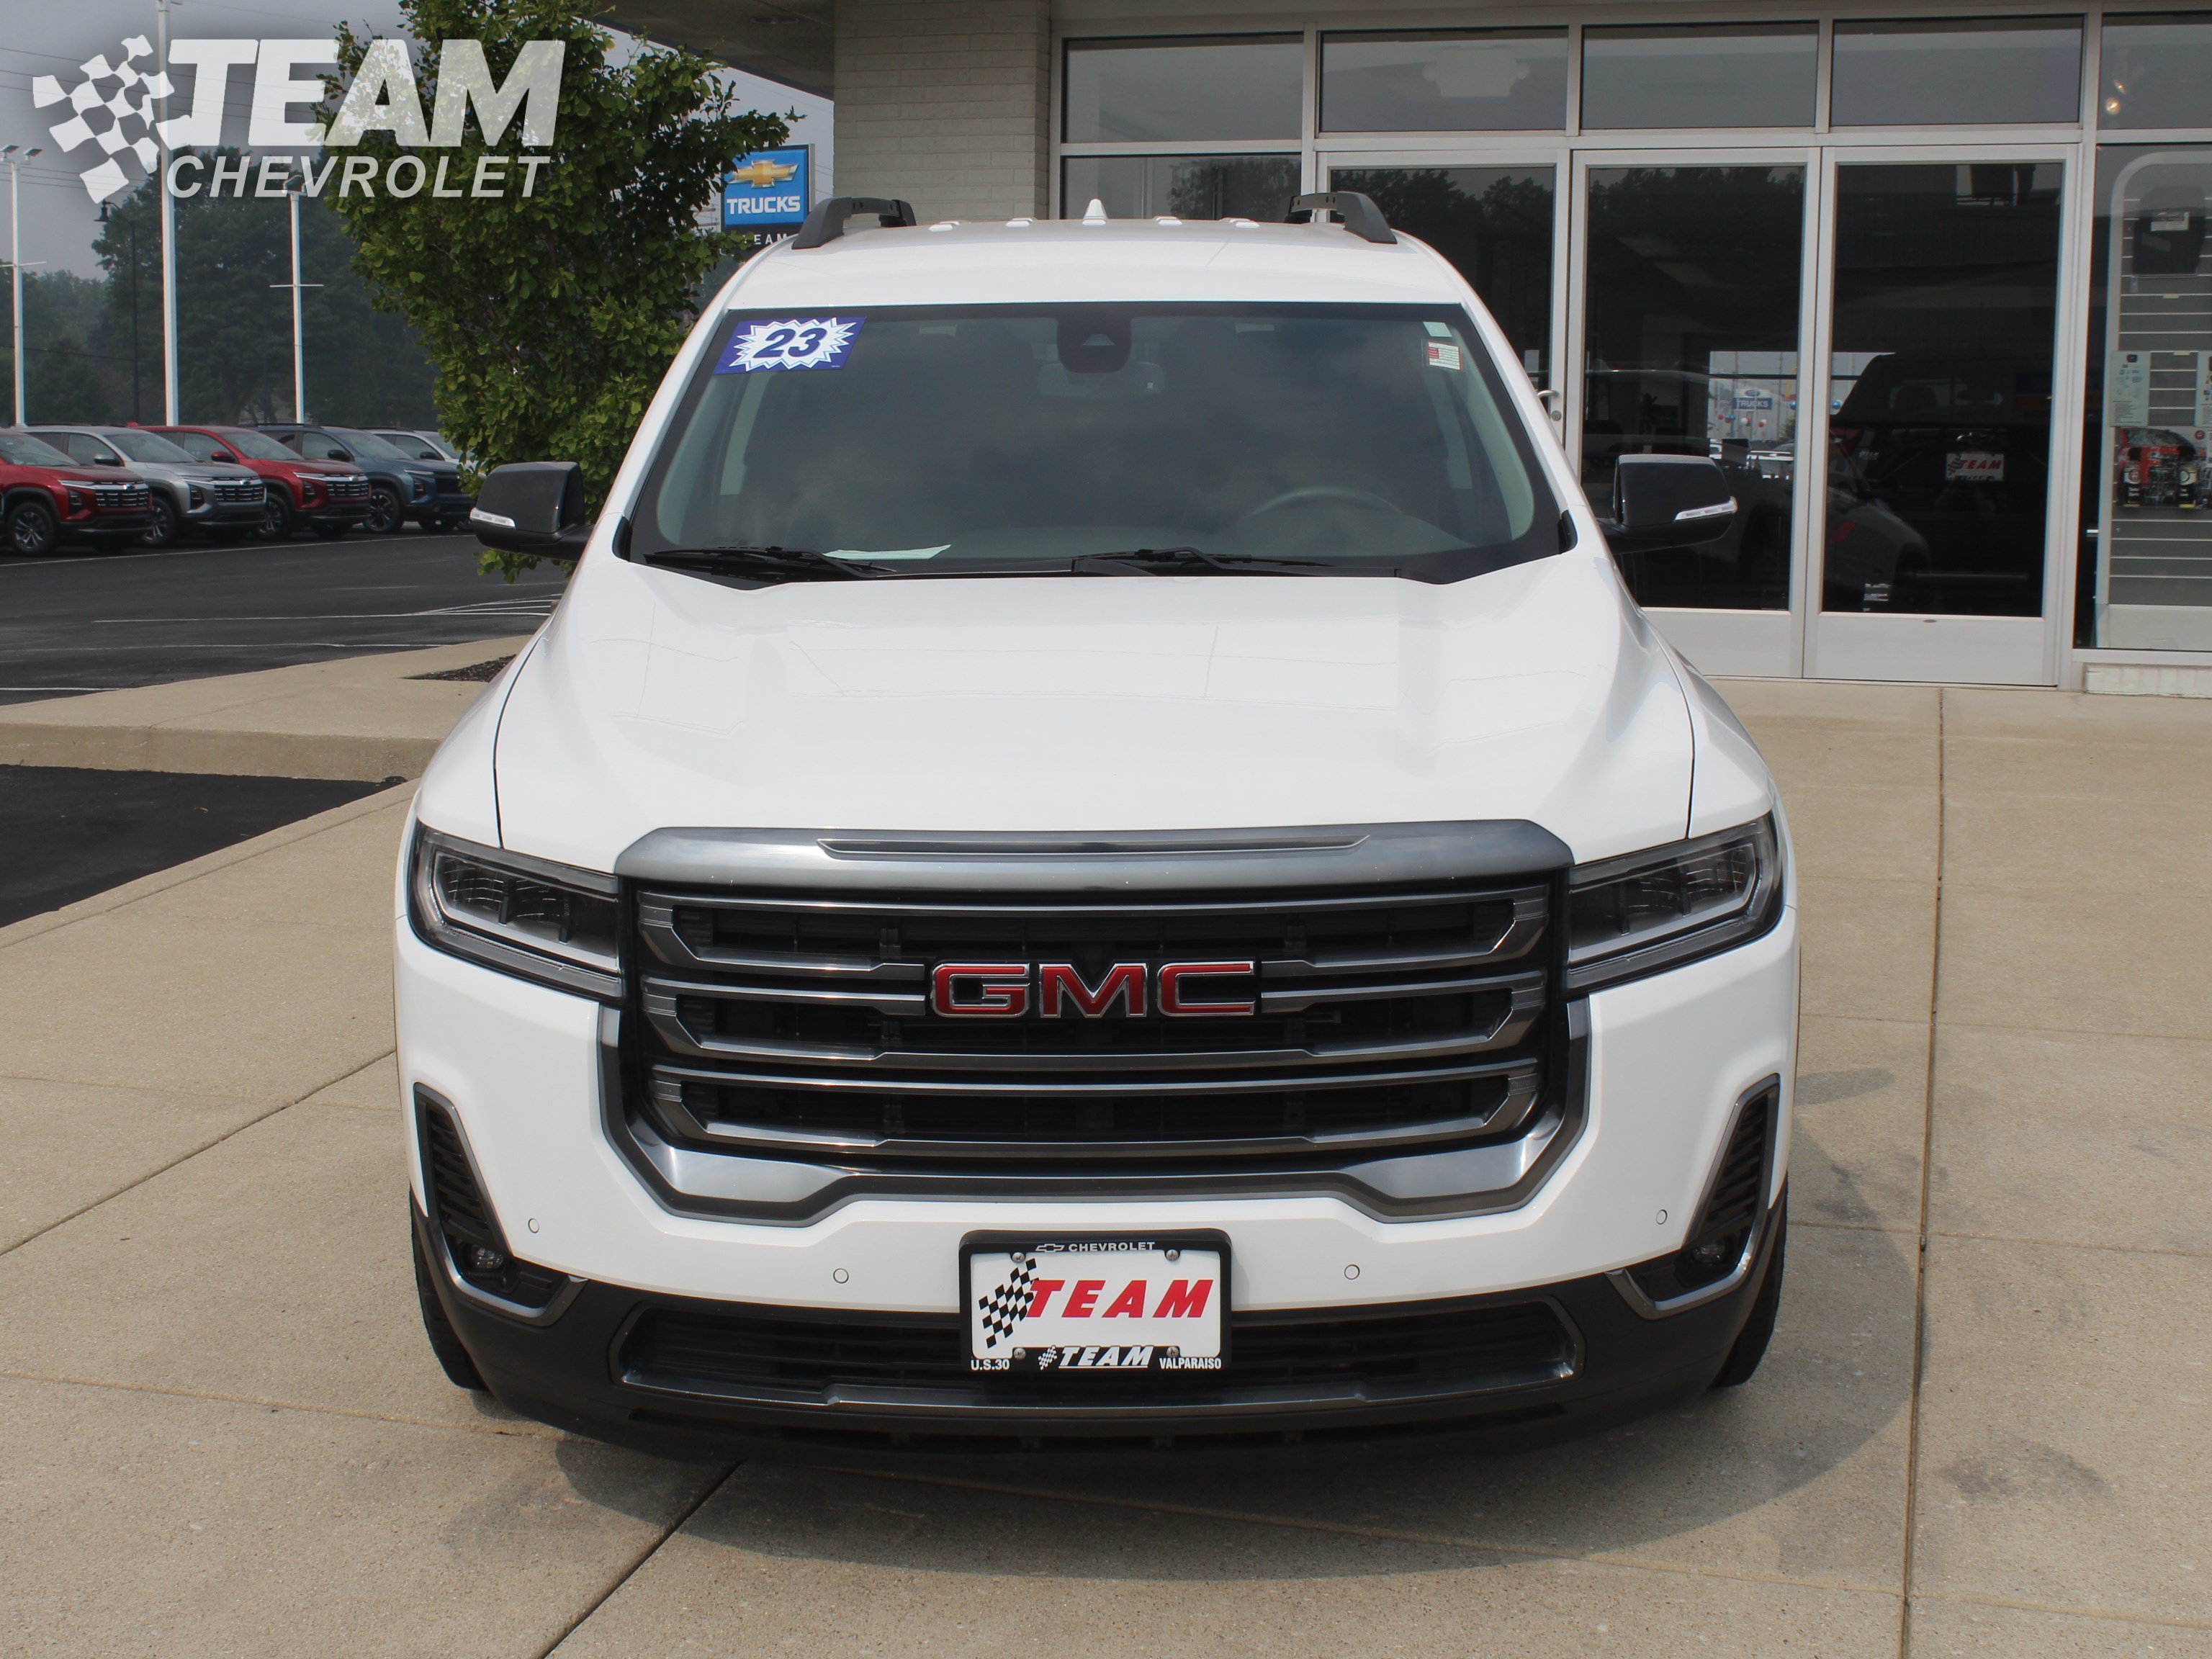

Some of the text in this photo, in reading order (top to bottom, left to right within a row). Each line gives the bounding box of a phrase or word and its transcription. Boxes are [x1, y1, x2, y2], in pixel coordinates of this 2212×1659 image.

[727, 195, 801, 215] TRUCKS
[752, 328, 828, 359] 23
[1957, 459, 2002, 469] TEAM
[931, 960, 1256, 1018] GMC
[1068, 1241, 1156, 1252] CHEVROLET
[1025, 1279, 1214, 1318] TEAM
[1058, 1345, 1154, 1367] TEAM
[1159, 1357, 1222, 1370] VALPARAISO
